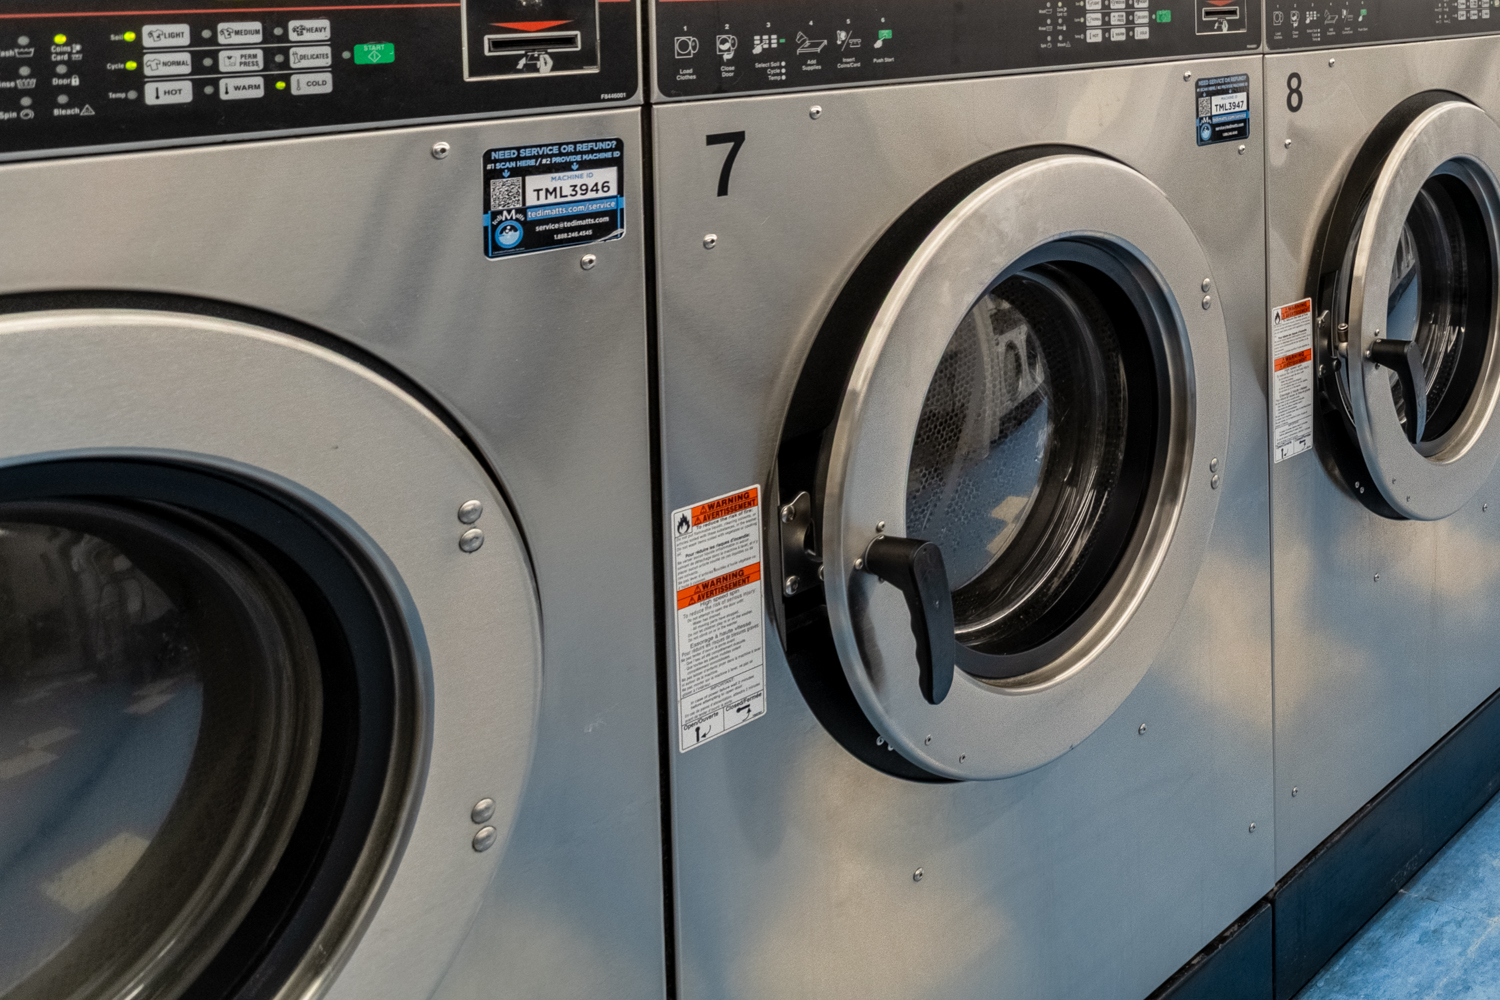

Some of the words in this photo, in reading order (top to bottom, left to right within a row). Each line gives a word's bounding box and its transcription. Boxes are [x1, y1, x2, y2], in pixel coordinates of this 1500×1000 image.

[110, 32, 124, 41] Soil
[163, 30, 185, 39] LIGHT
[234, 28, 261, 37] MEDIUM
[306, 26, 327, 35] HEAVY
[50, 45, 71, 53] Coins
[51, 53, 69, 61] Card
[106, 62, 125, 71] Cycle
[162, 59, 190, 68] NORMAL
[299, 52, 329, 61] DELICATES
[239, 60, 259, 68] PRESS
[52, 77, 71, 85] Door
[676, 73, 697, 81] Clothes
[766, 67, 780, 75] Cycle
[768, 74, 781, 82] Temp
[108, 91, 126, 100] Temp
[163, 88, 183, 96] HOT
[306, 79, 327, 87] COLD
[1286, 71, 1303, 113] 8
[53, 107, 80, 116] Bleach
[1214, 100, 1244, 112] TML3947
[491, 150, 518, 160] NEED
[519, 145, 559, 157] SERVICE
[560, 144, 575, 153] OR
[576, 140, 617, 152] REFUND?
[495, 161, 516, 170] SCAN
[517, 159, 536, 167] HERE
[541, 157, 551, 165] #2
[551, 154, 582, 164] PROVIDE
[582, 151, 613, 160] MACHINE
[613, 150, 621, 158] ID
[705, 130, 746, 197] 7
[551, 173, 585, 182] MACHINE
[533, 181, 611, 202] TML3946
[527, 200, 616, 218] tedimatts.com/service
[535, 216, 610, 232] service@tedimatts.com
[707, 492, 750, 511] WARNING
[703, 499, 756, 524] AVERTISSEMENT
[702, 569, 745, 590] WARNING
[697, 576, 750, 602] AVERTISSEMENT
